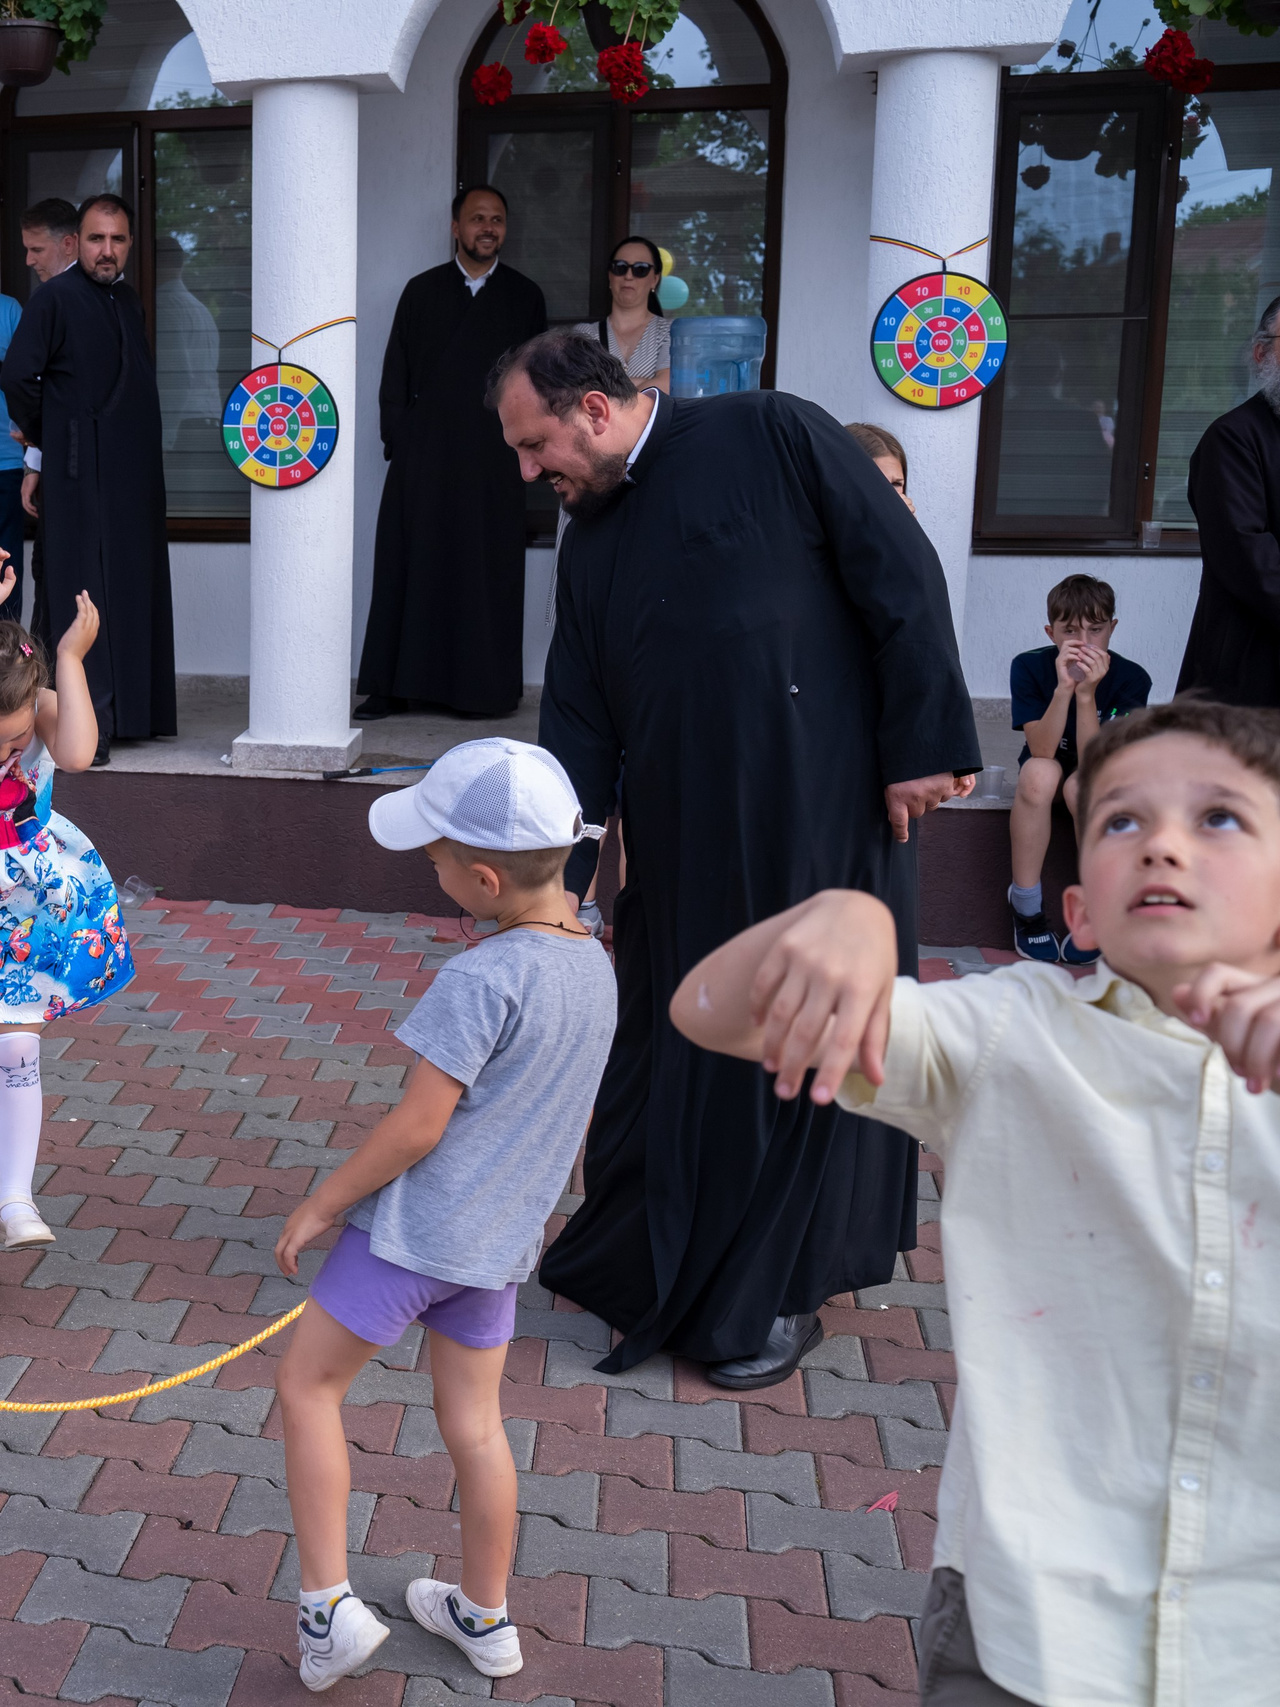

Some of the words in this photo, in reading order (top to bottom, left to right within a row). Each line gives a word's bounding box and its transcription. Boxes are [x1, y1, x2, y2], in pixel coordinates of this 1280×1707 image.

[916, 287, 928, 295] 10
[958, 286, 970, 295] 10
[883, 318, 895, 326] 10
[989, 317, 1001, 325] 10
[987, 358, 999, 366] 10
[911, 389, 923, 397] 10
[230, 403, 240, 411] 10
[317, 404, 328, 412] 10
[229, 441, 239, 449] 10
[1028, 934, 1050, 944] PUMA
